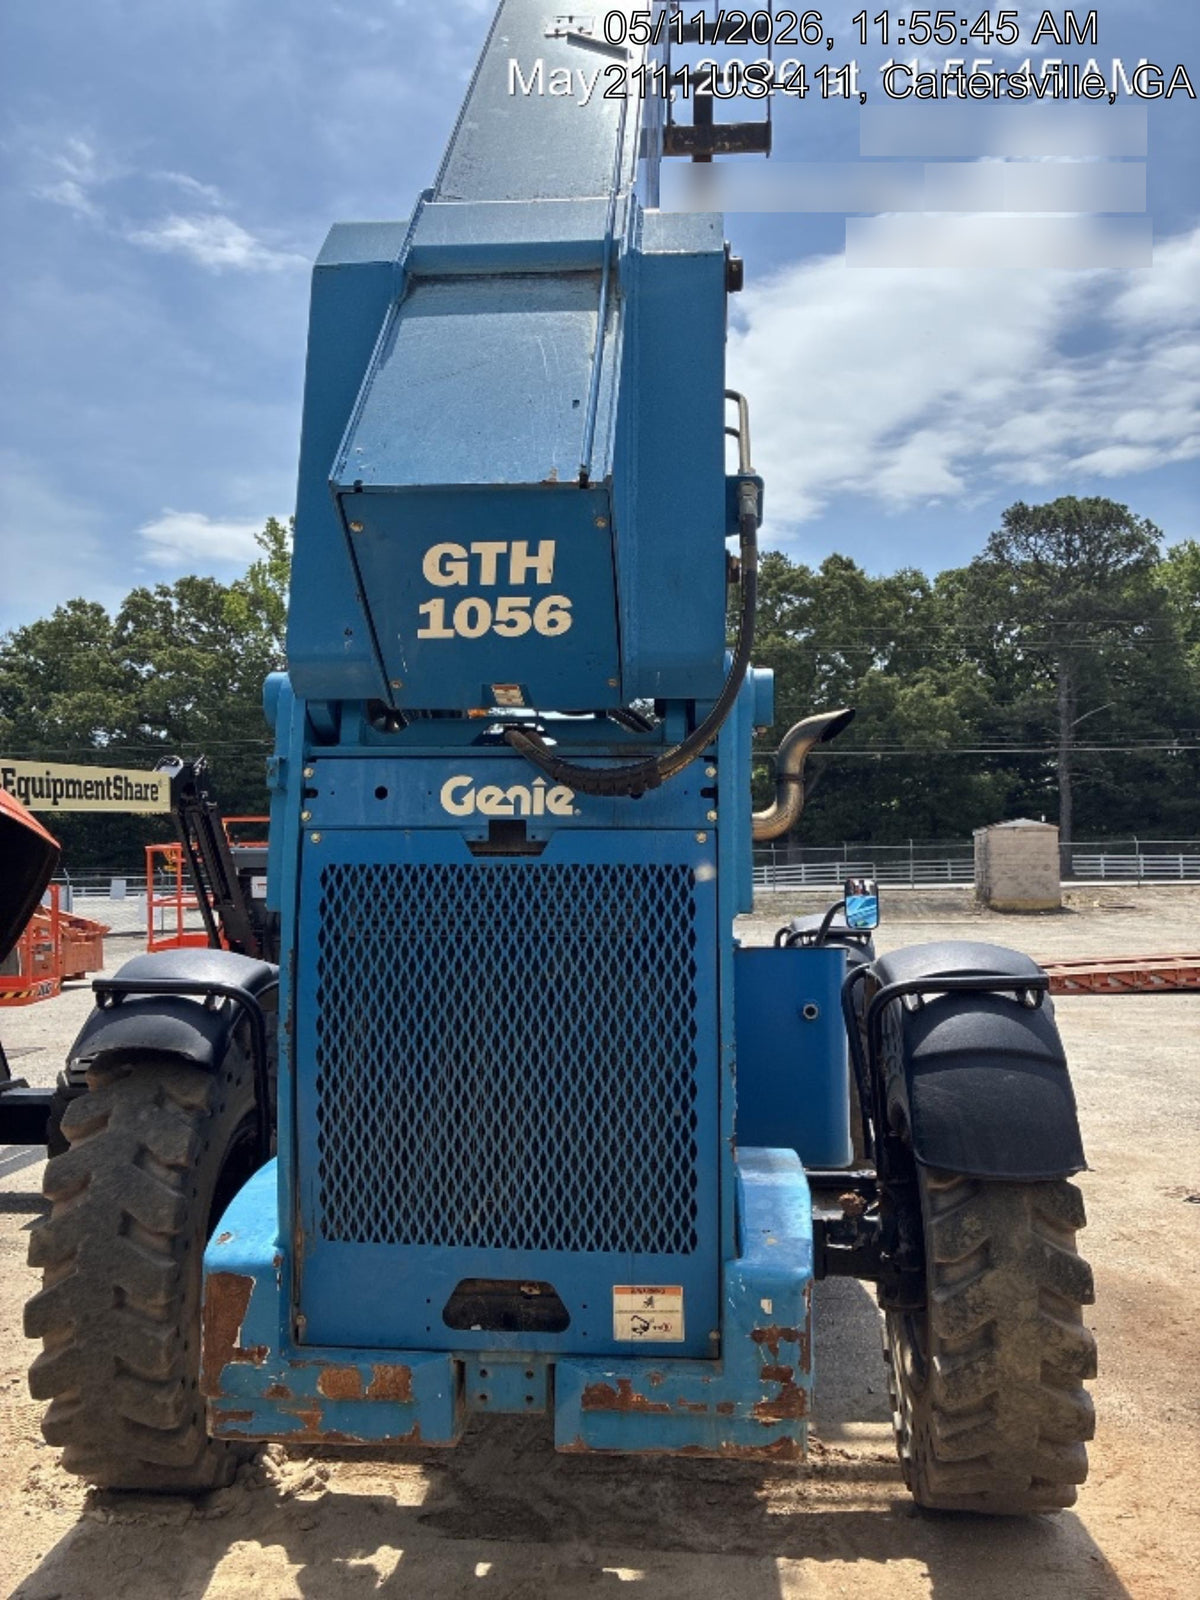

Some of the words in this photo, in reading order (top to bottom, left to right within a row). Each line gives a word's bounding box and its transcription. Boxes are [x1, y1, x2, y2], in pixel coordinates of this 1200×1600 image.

[422, 540, 556, 587] GTH
[417, 595, 573, 640] 1056
[1, 768, 159, 806] EquipmentShare
[440, 774, 576, 817] Genie
